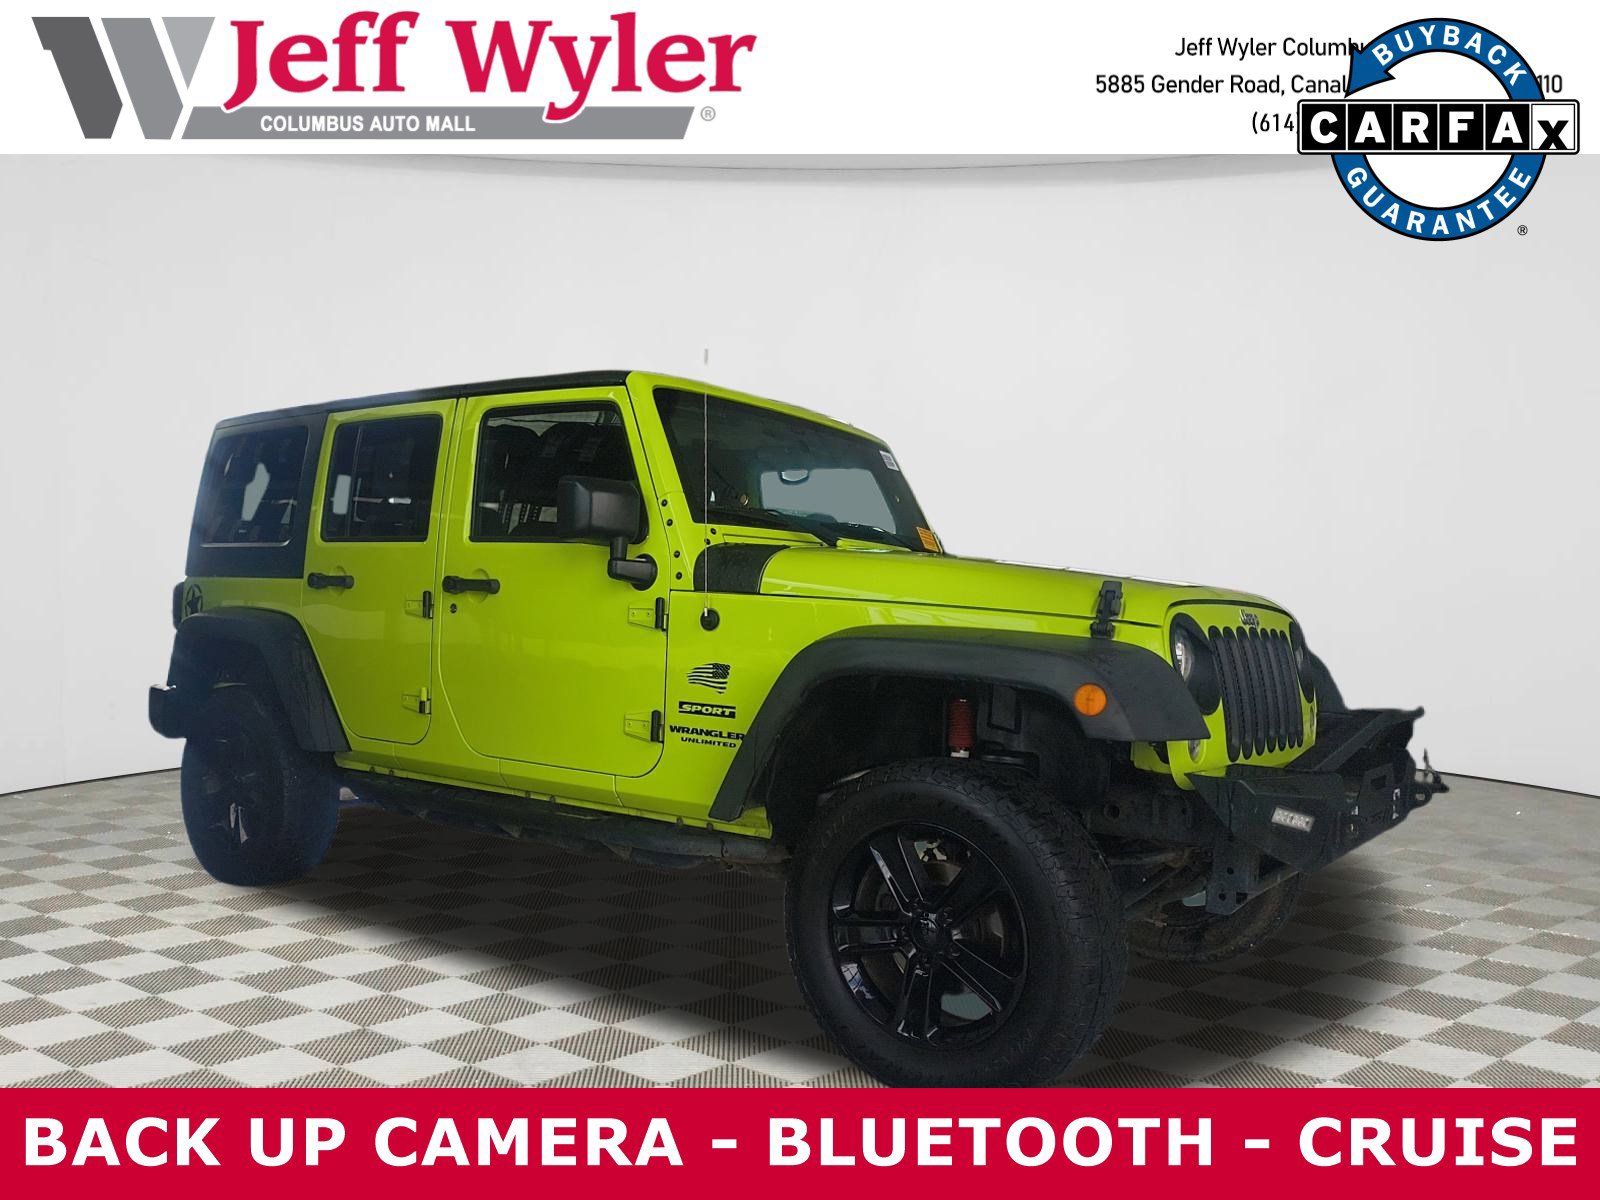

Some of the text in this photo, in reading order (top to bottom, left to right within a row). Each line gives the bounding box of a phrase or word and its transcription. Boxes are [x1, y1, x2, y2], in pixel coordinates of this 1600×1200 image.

[681, 703, 733, 716] SPORT
[669, 724, 746, 741] WRANGLER
[680, 736, 737, 748] UNLIMITED
